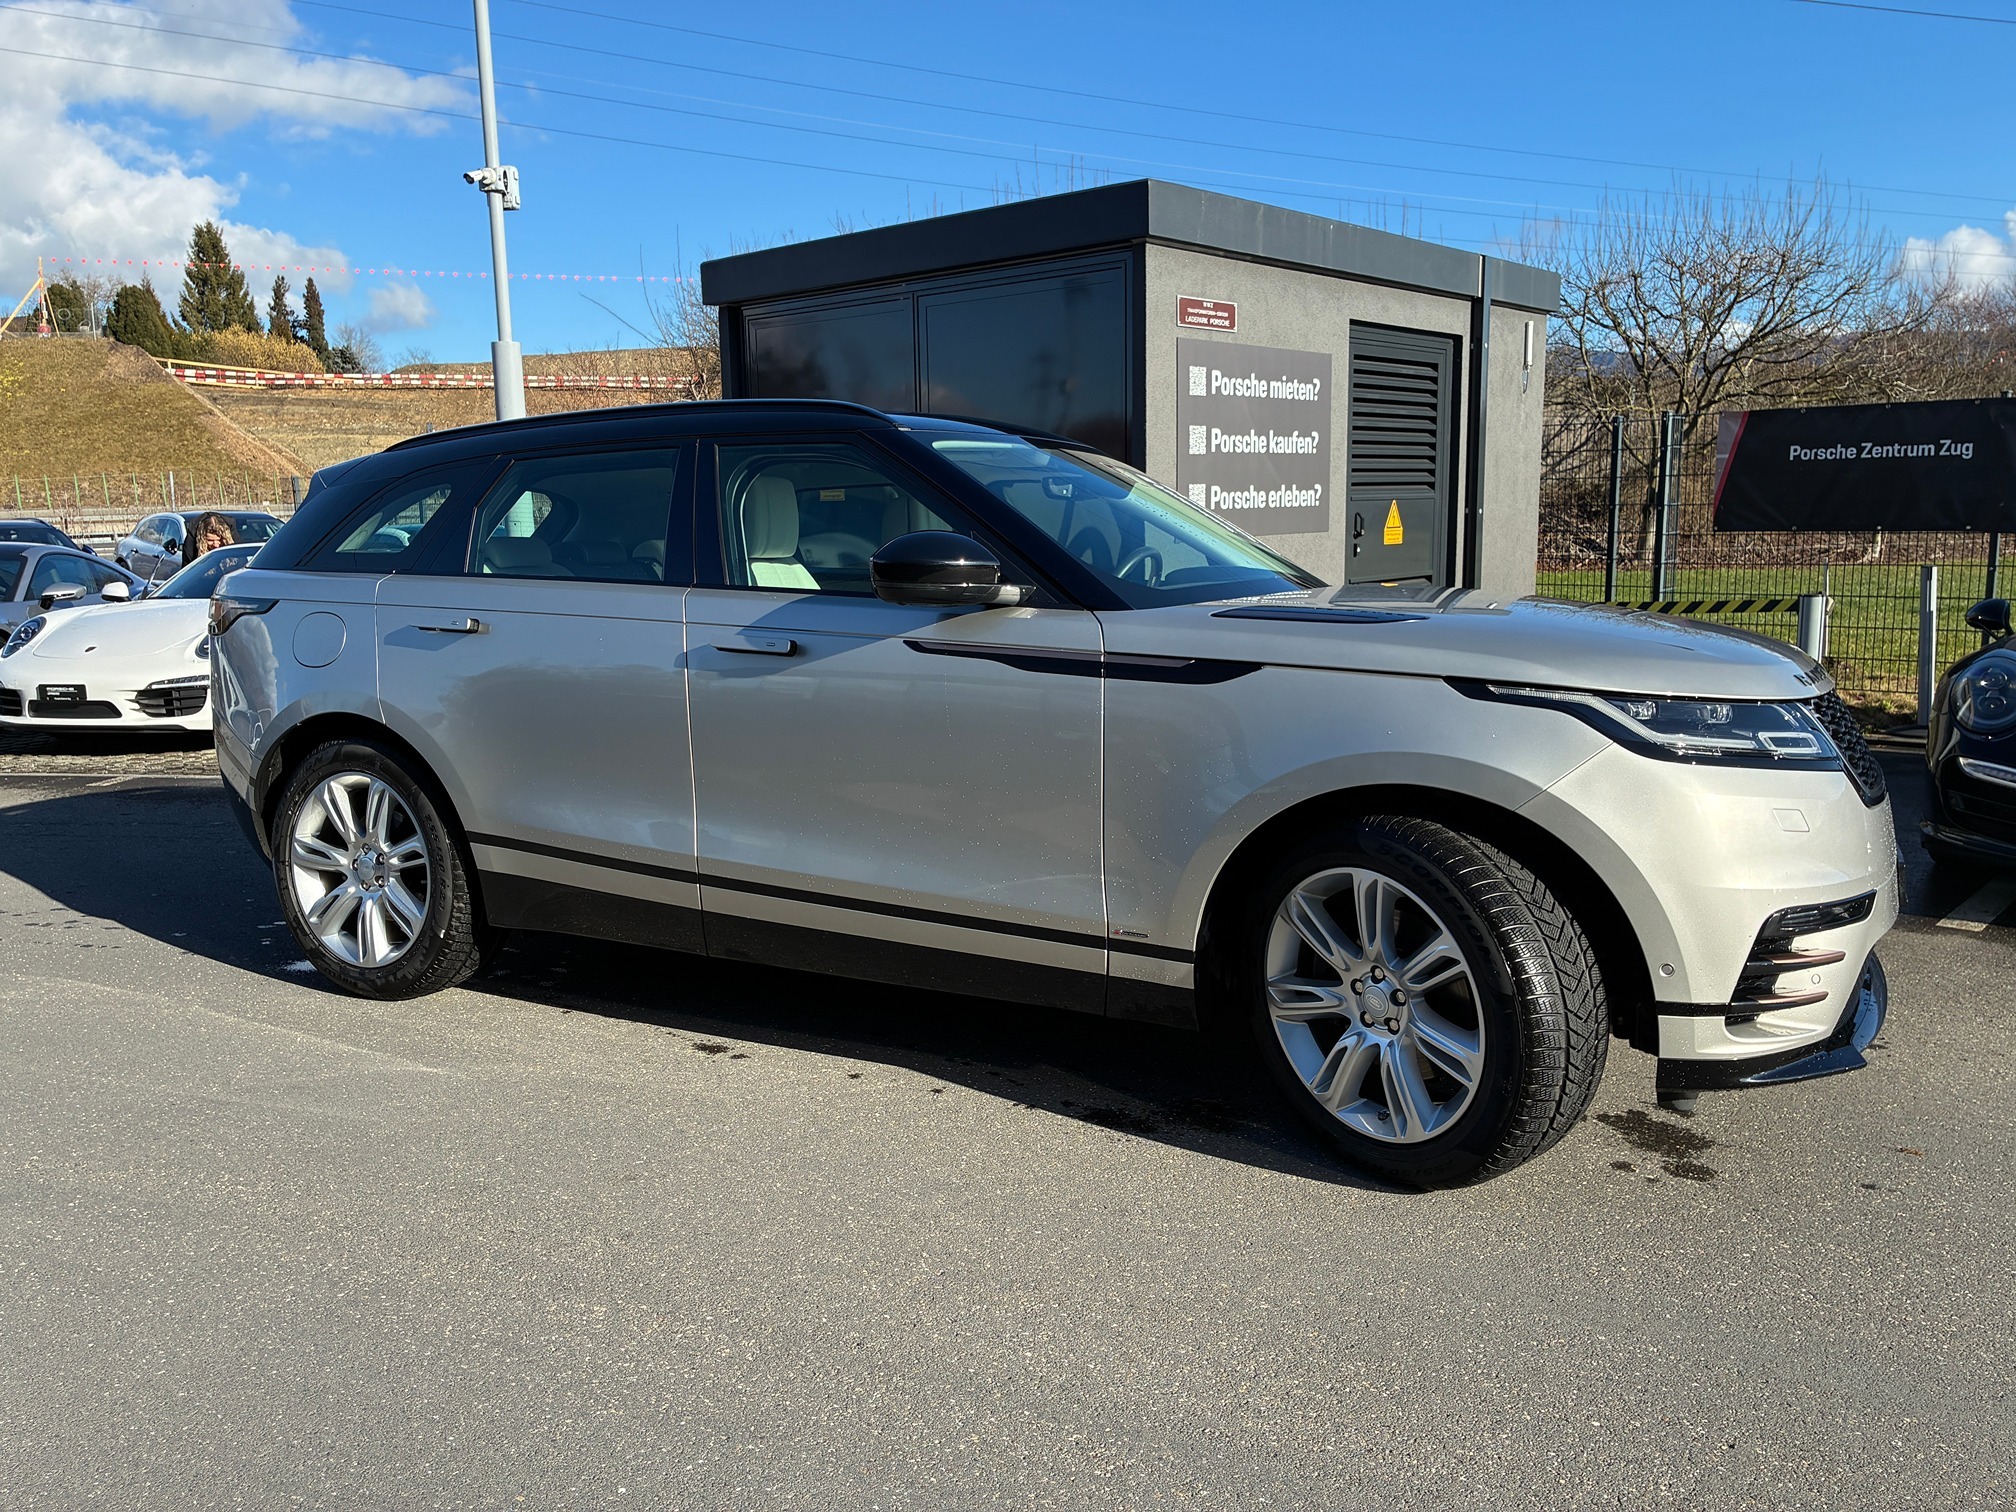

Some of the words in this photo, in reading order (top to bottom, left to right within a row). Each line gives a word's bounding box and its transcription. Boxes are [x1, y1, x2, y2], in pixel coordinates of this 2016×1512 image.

[1185, 316, 1208, 324] LADEPARK
[1210, 317, 1230, 327] PORSCHE
[1211, 369, 1268, 398] Porsche
[1269, 375, 1321, 401] mieten?
[1211, 427, 1267, 454] Porsche
[1269, 429, 1319, 454] kaufen?
[1789, 444, 1857, 461] Porsche
[1860, 442, 1935, 459] Zentrum
[1939, 439, 1974, 459] Zug
[1210, 484, 1267, 510] Porsche
[1268, 483, 1322, 508] erleben?
[1375, 843, 1497, 966] SCORPION
